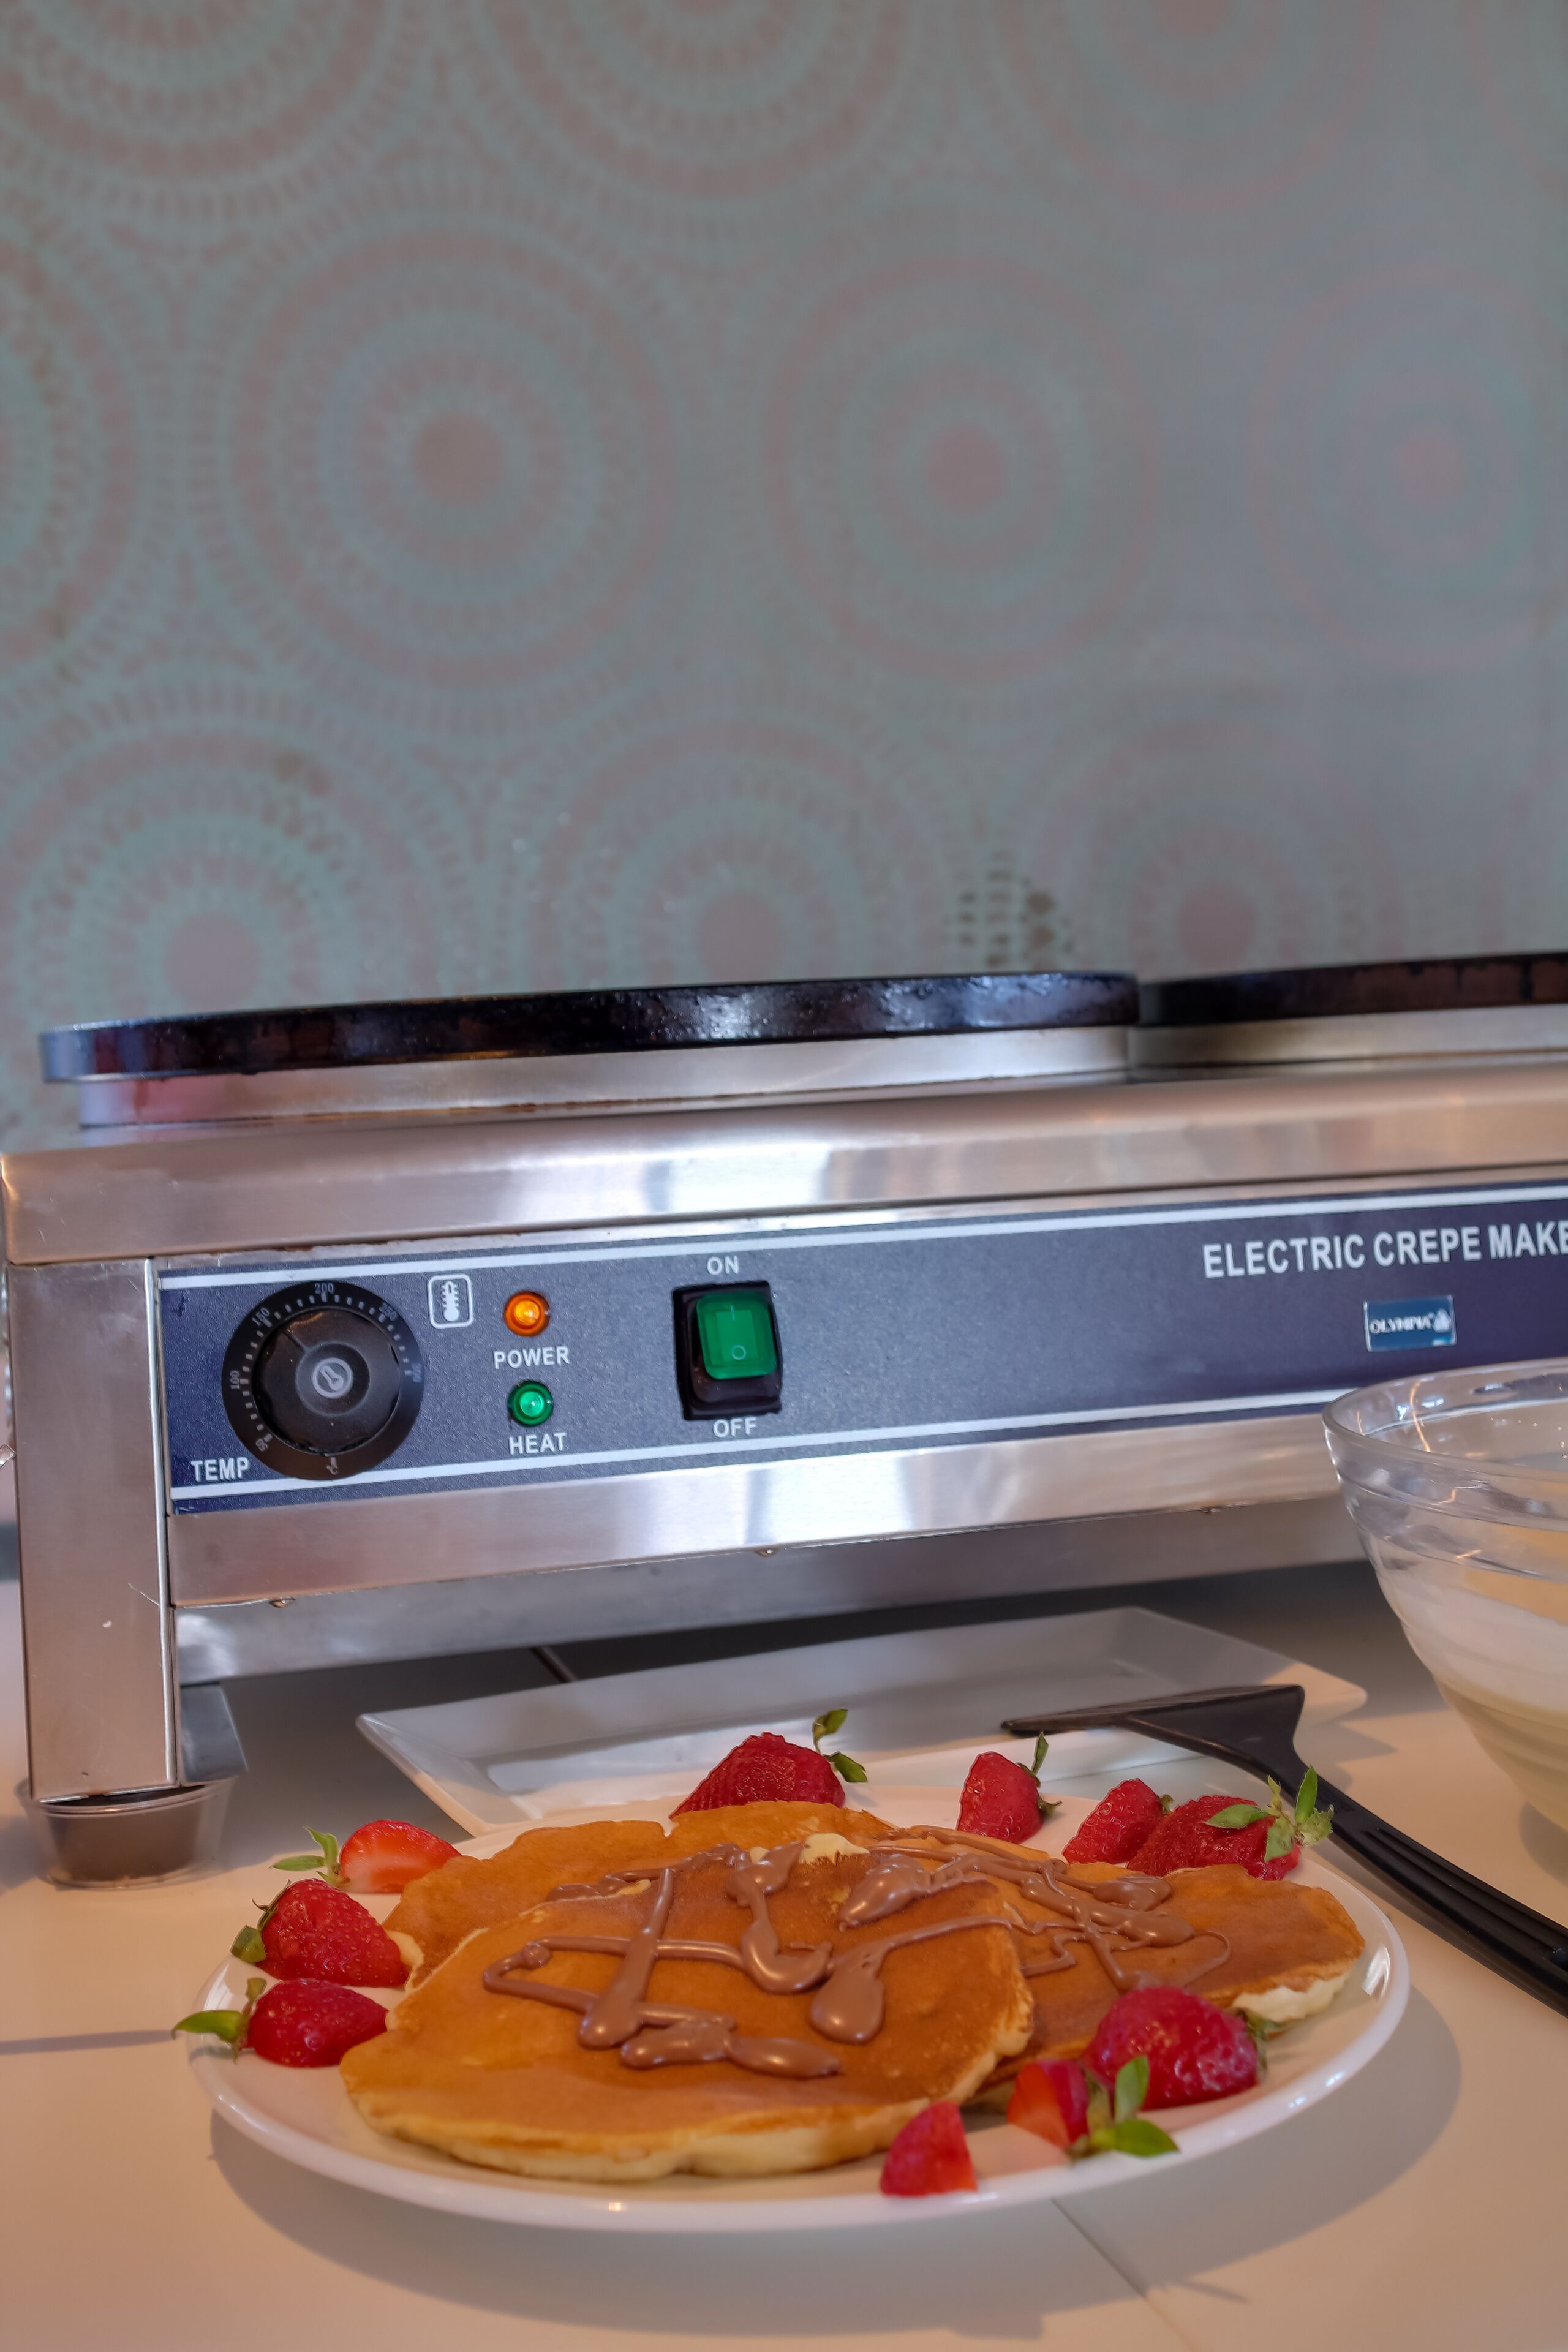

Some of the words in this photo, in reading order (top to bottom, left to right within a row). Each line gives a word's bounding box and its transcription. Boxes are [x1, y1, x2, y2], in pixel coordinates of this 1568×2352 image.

[1203, 1234, 1366, 1278] ELECTRIC
[1373, 1226, 1483, 1267] CREPE
[707, 1256, 739, 1275] ON
[314, 1283, 334, 1294] 200
[379, 1303, 397, 1320] 250
[493, 1346, 570, 1370] POWER
[230, 1370, 240, 1389] 100
[712, 1417, 757, 1438] OFF
[255, 1439, 268, 1452] 50
[508, 1431, 567, 1455] HEAT
[191, 1457, 249, 1482] TEMP
